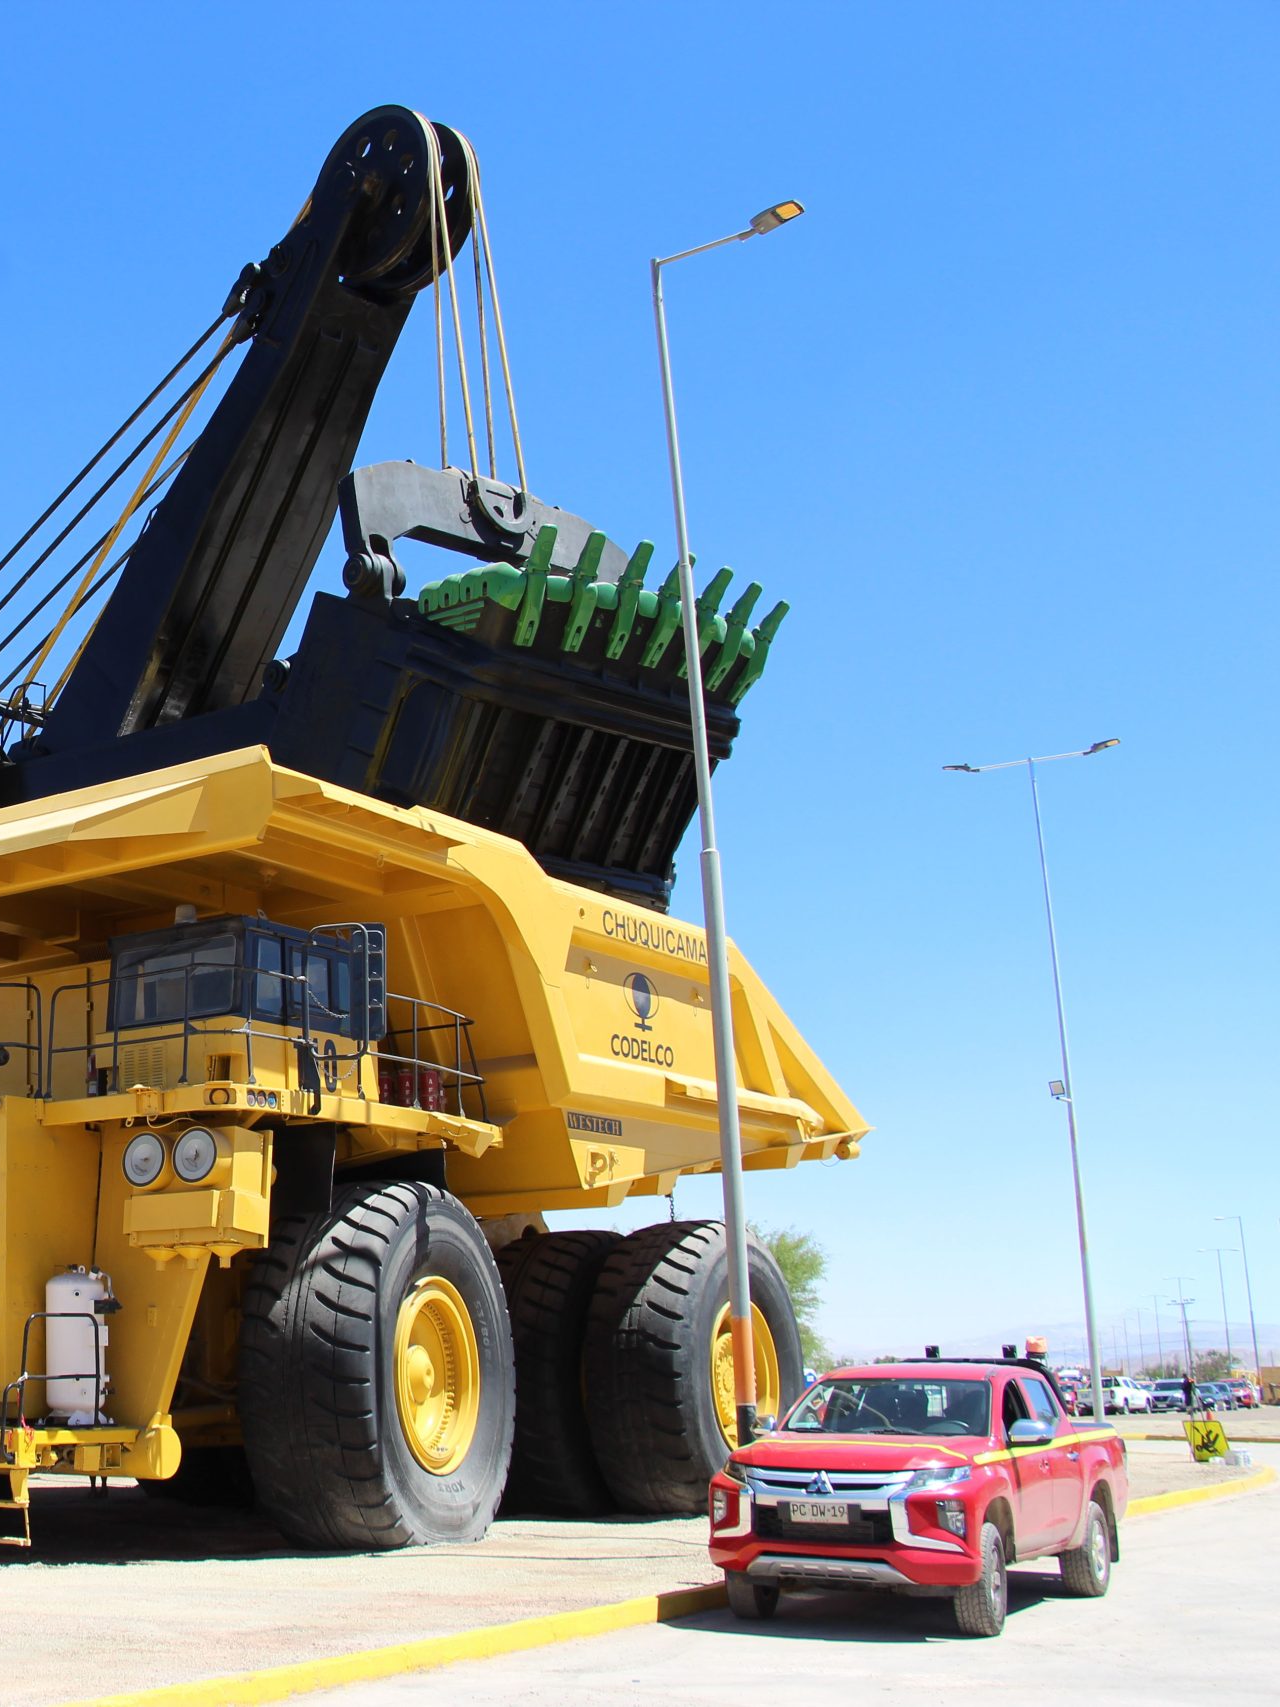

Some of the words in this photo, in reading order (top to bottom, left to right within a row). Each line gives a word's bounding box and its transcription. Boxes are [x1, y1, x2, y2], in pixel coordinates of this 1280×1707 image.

[602, 910, 728, 964] CHUQUICAMA
[611, 1034, 674, 1068] CODELCO
[569, 1113, 620, 1135] WESTECH
[792, 1504, 806, 1516] PC
